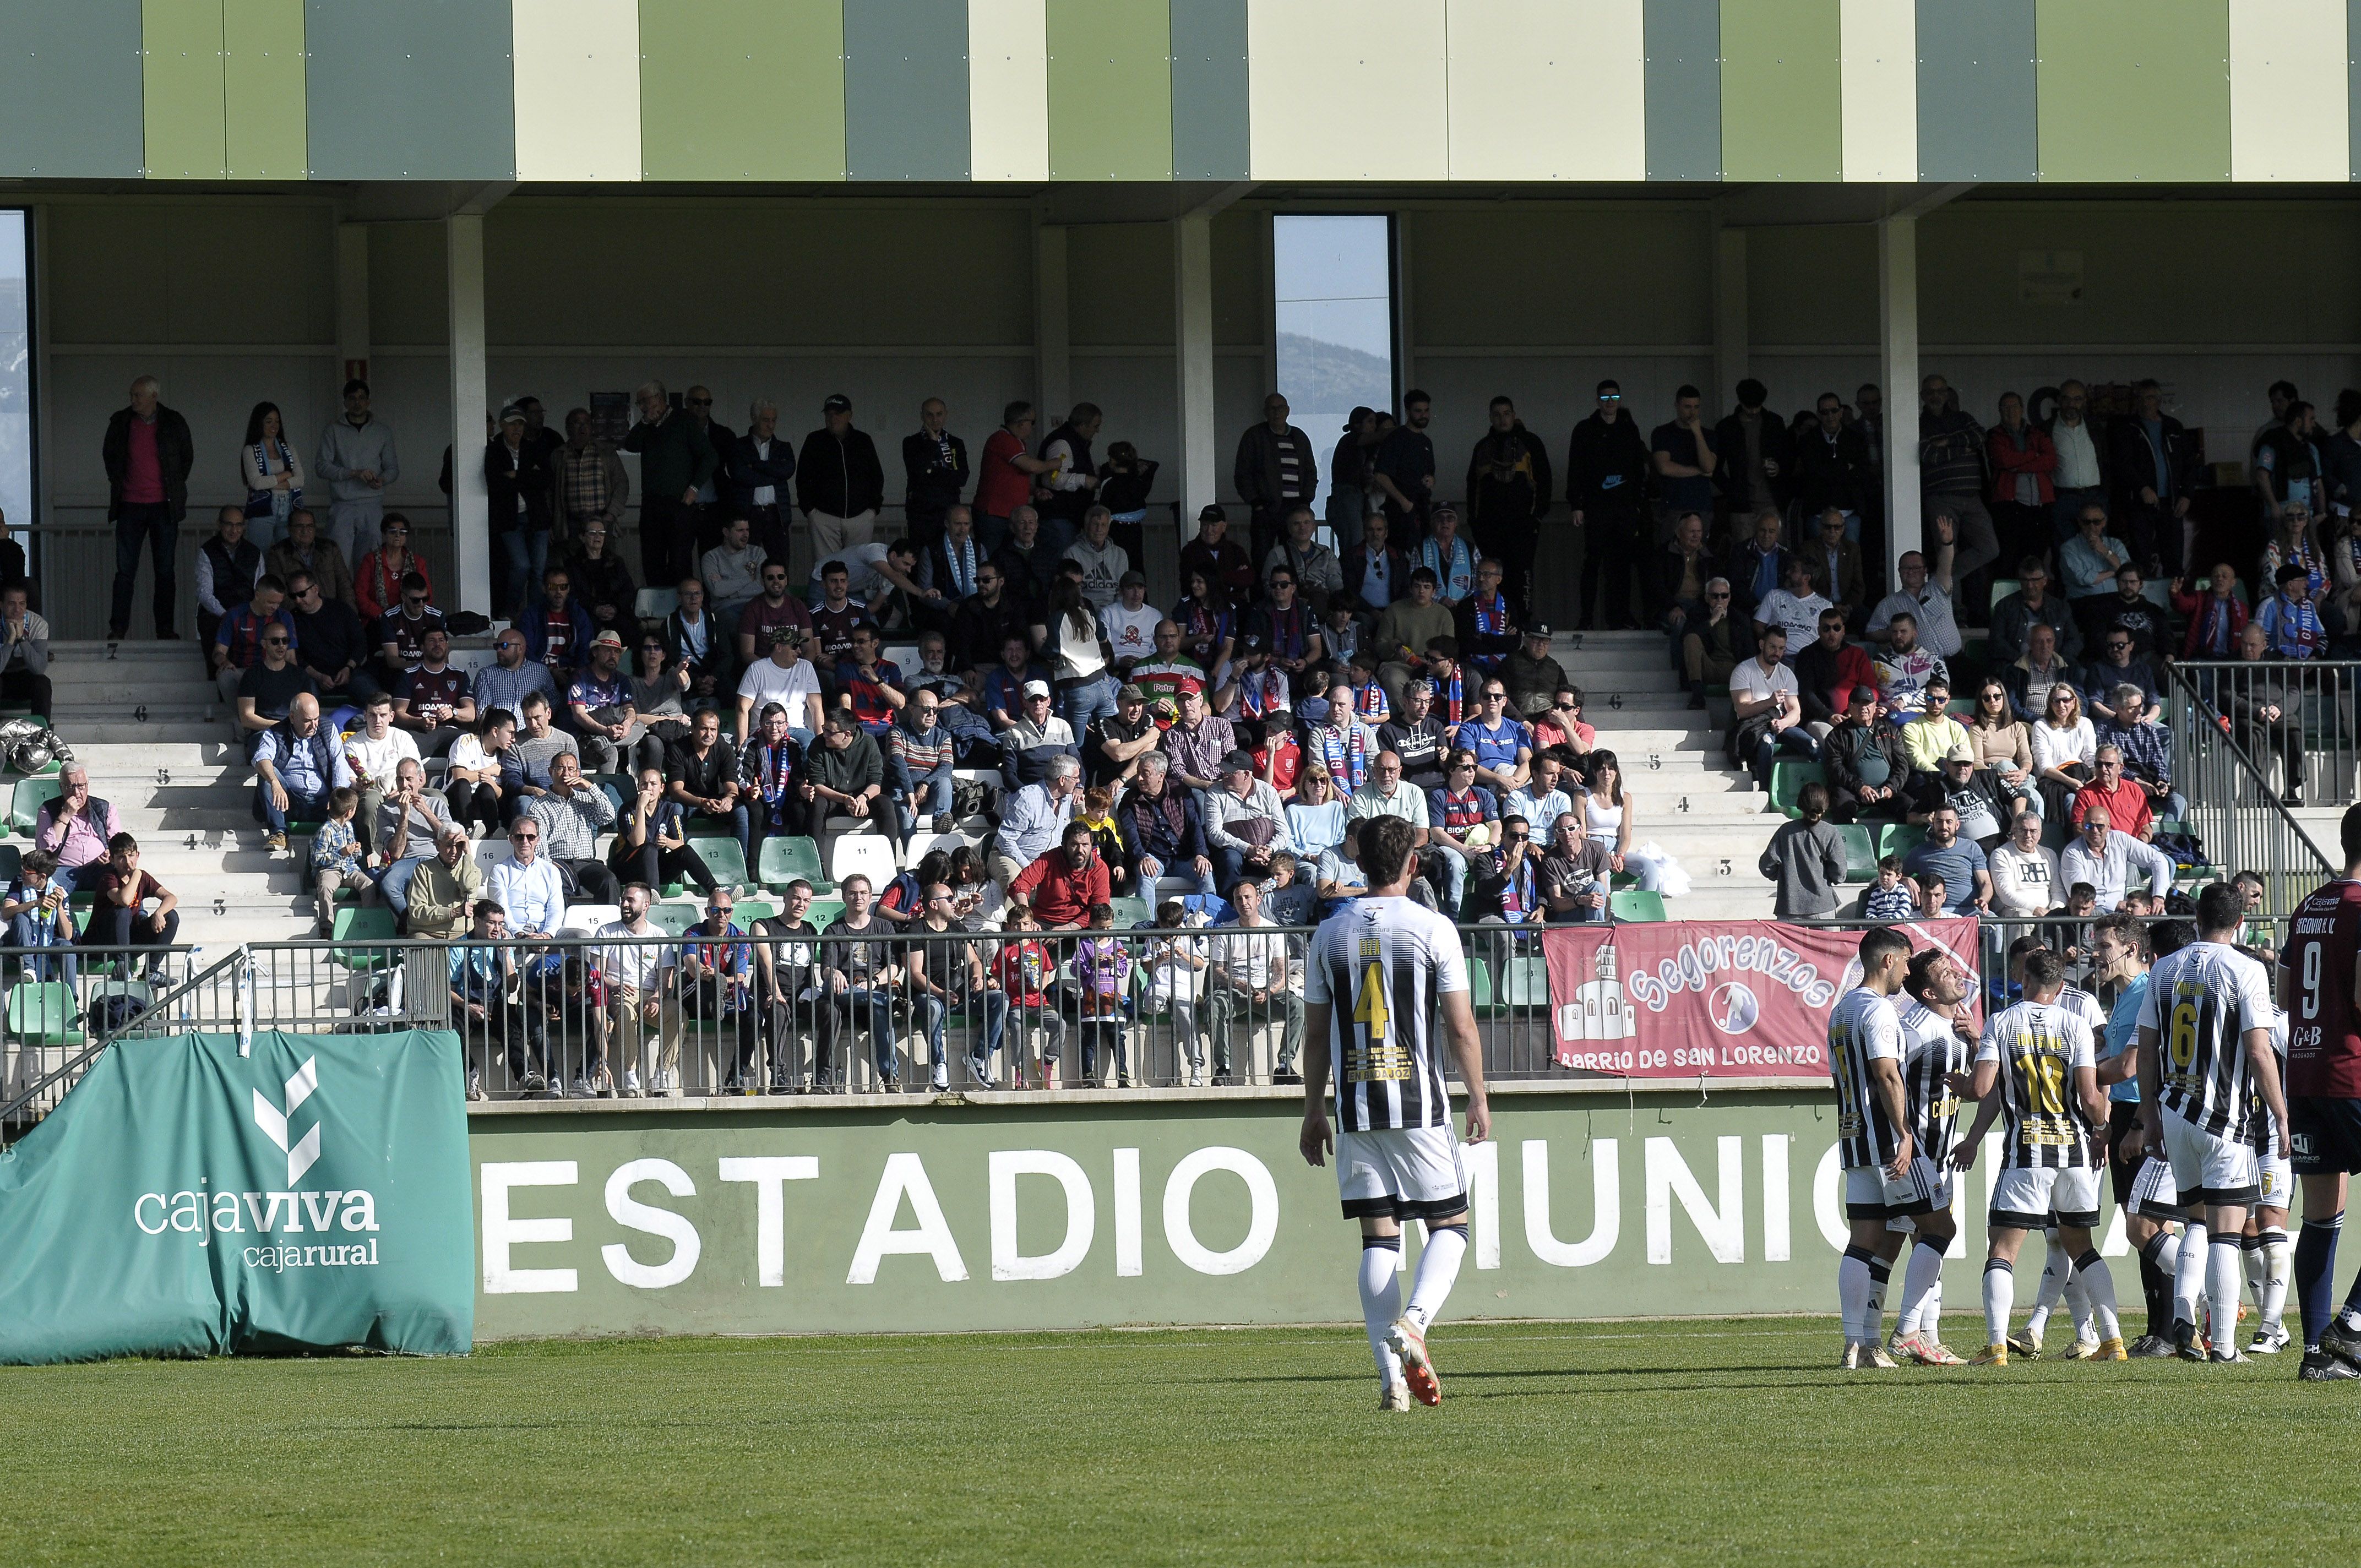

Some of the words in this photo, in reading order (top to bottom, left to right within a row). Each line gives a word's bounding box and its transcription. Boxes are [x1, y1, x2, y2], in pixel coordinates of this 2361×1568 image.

[1082, 578, 1119, 591] adidas
[1573, 635, 1583, 650] 7
[107, 643, 118, 660] 7
[1154, 683, 1175, 693] Petro
[1609, 694, 1622, 710] 6
[135, 706, 148, 722] 6
[1650, 755, 1661, 770] 5
[157, 769, 170, 785] 5
[1678, 797, 1689, 812] 4
[183, 834, 197, 850] 4
[1720, 859, 1731, 875] 3
[213, 899, 226, 916] 3
[1352, 925, 1390, 934] Extremadura
[1629, 934, 1835, 1012] Segorenzos
[2303, 941, 2321, 1020] 9
[1353, 960, 1389, 1039] 4
[2172, 1003, 2198, 1067] 6
[2293, 1026, 2322, 1047] G&B
[1348, 1071, 1362, 1081] EN
[1363, 1068, 1410, 1080] BADAJOZ
[1833, 1045, 1852, 1104] 5
[2016, 1053, 2066, 1114] 18
[2023, 1135, 2036, 1143] EN
[2037, 1135, 2074, 1144] BADAJOZ
[2261, 1172, 2273, 1195] 8
[134, 1178, 380, 1247] cajaviva
[481, 1146, 1279, 1294] ESTADIO
[244, 1238, 378, 1273] cajarural
